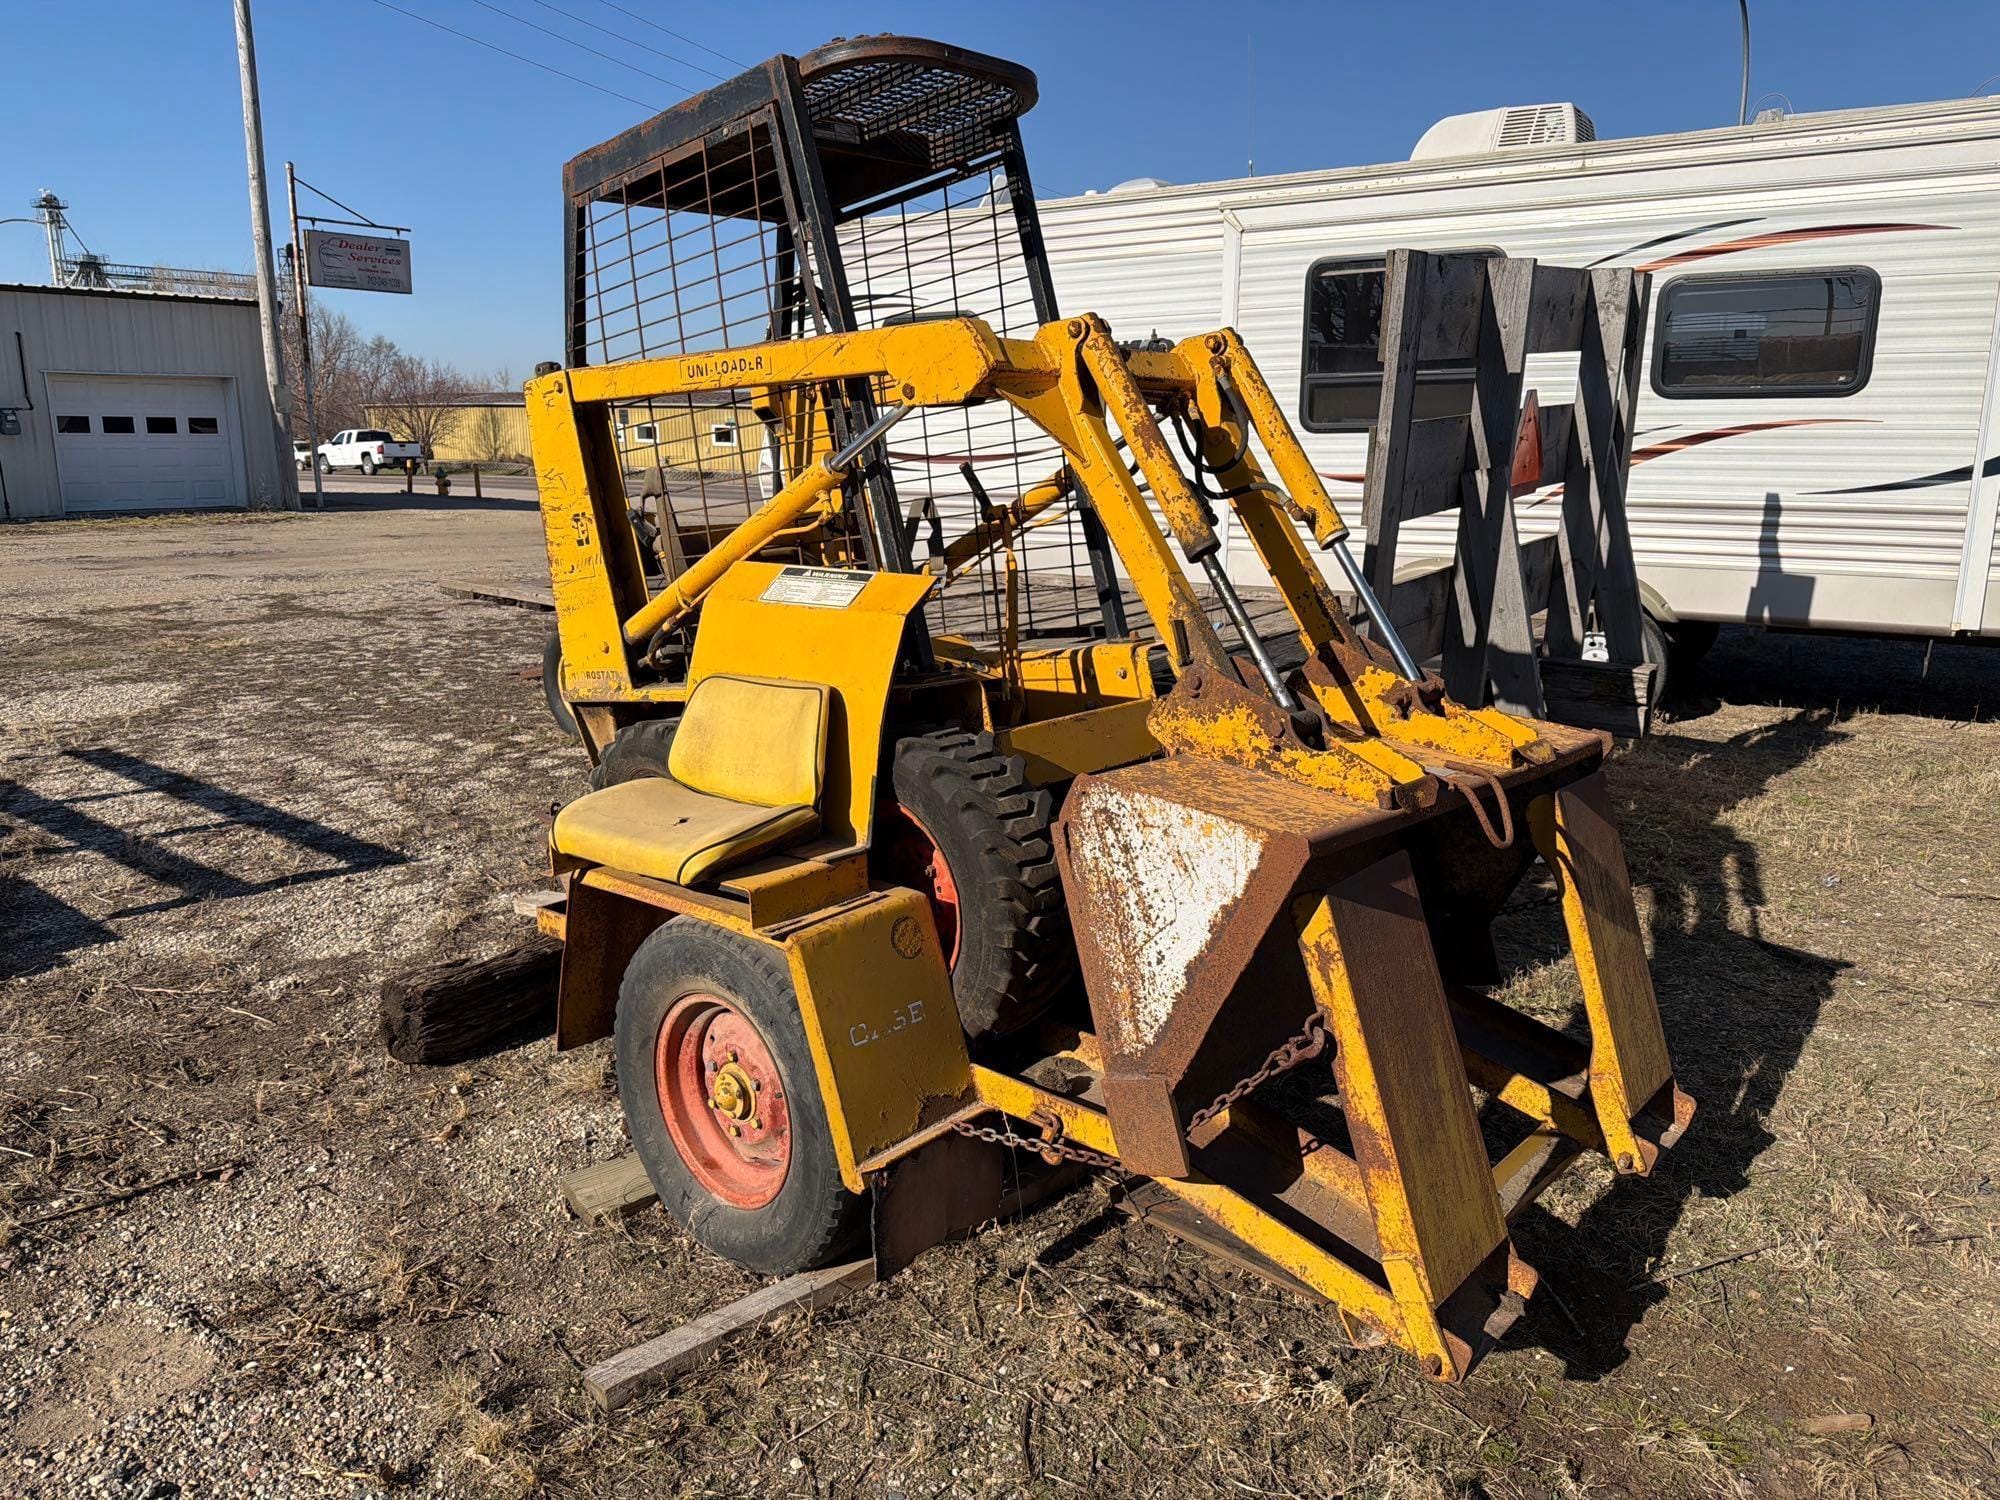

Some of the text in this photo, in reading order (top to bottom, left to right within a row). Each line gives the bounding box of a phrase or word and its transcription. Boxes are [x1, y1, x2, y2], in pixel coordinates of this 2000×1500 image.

[339, 240, 382, 252] Dealer
[348, 253, 401, 266] Services
[811, 571, 849, 580] WARNING
